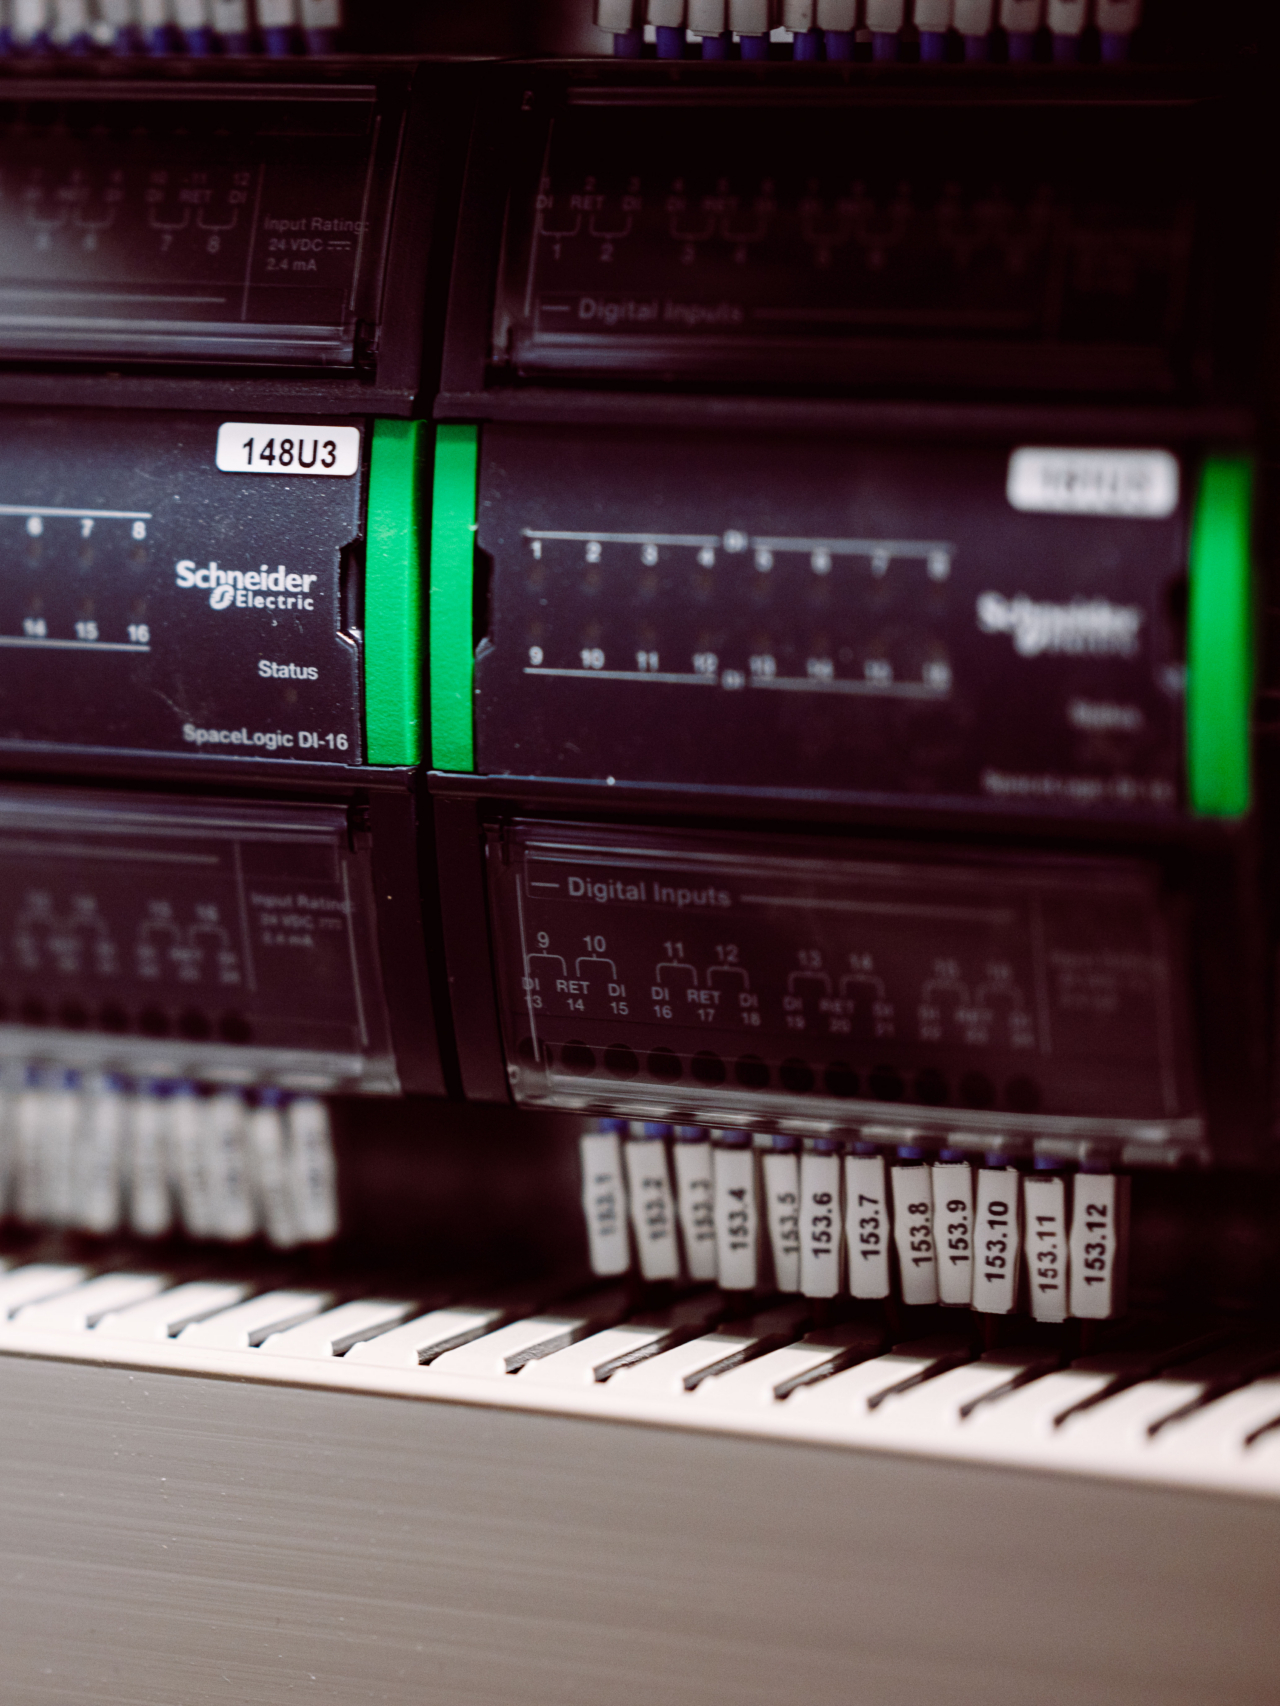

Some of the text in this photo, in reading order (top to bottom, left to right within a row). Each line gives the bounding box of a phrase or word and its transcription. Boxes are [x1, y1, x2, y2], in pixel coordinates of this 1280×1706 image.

[229, 189, 248, 205] DI
[570, 194, 606, 211] RET
[264, 216, 370, 236] Input Rating:
[269, 238, 323, 252] 24 VDC
[552, 242, 562, 261] 1
[599, 241, 614, 262] 2
[267, 257, 317, 272] 2.4 mA
[578, 297, 746, 328] Digital Inputs
[243, 437, 337, 469] 148U3
[81, 517, 94, 539] 7
[131, 519, 146, 541] 8
[531, 539, 542, 560] 1
[585, 541, 602, 564] 2
[175, 559, 317, 593] Schneider
[235, 590, 315, 612] Electric
[74, 620, 99, 642] 15
[127, 623, 150, 645] 16
[258, 659, 319, 681] Status
[529, 645, 543, 667] 9
[580, 647, 605, 670] 10
[636, 649, 659, 672] 11
[182, 723, 349, 751] SpaceLogic DI-16
[567, 875, 733, 909] Digital Inputs
[536, 930, 551, 949] 9
[582, 934, 607, 953] 10
[662, 940, 685, 959] 11
[714, 943, 740, 964] 12
[521, 976, 541, 991] DI
[556, 979, 591, 995] RET
[607, 982, 627, 999] DI
[650, 985, 670, 1002] DI
[687, 988, 722, 1006] RET
[738, 992, 760, 1009] DI
[566, 997, 586, 1012] 14
[609, 1001, 630, 1016] 15
[653, 1004, 674, 1020] 16
[696, 1008, 717, 1023] 17
[729, 1187, 749, 1251] 153.4
[777, 1192, 800, 1255] 153.5
[812, 1192, 833, 1259] 153.6
[858, 1194, 881, 1261] 153.7
[946, 1199, 970, 1266] 153.9
[907, 1202, 933, 1268] 153.8
[984, 1200, 1009, 1283] 153.10
[1084, 1203, 1108, 1286] 153.12
[1035, 1215, 1059, 1294] 153.11
